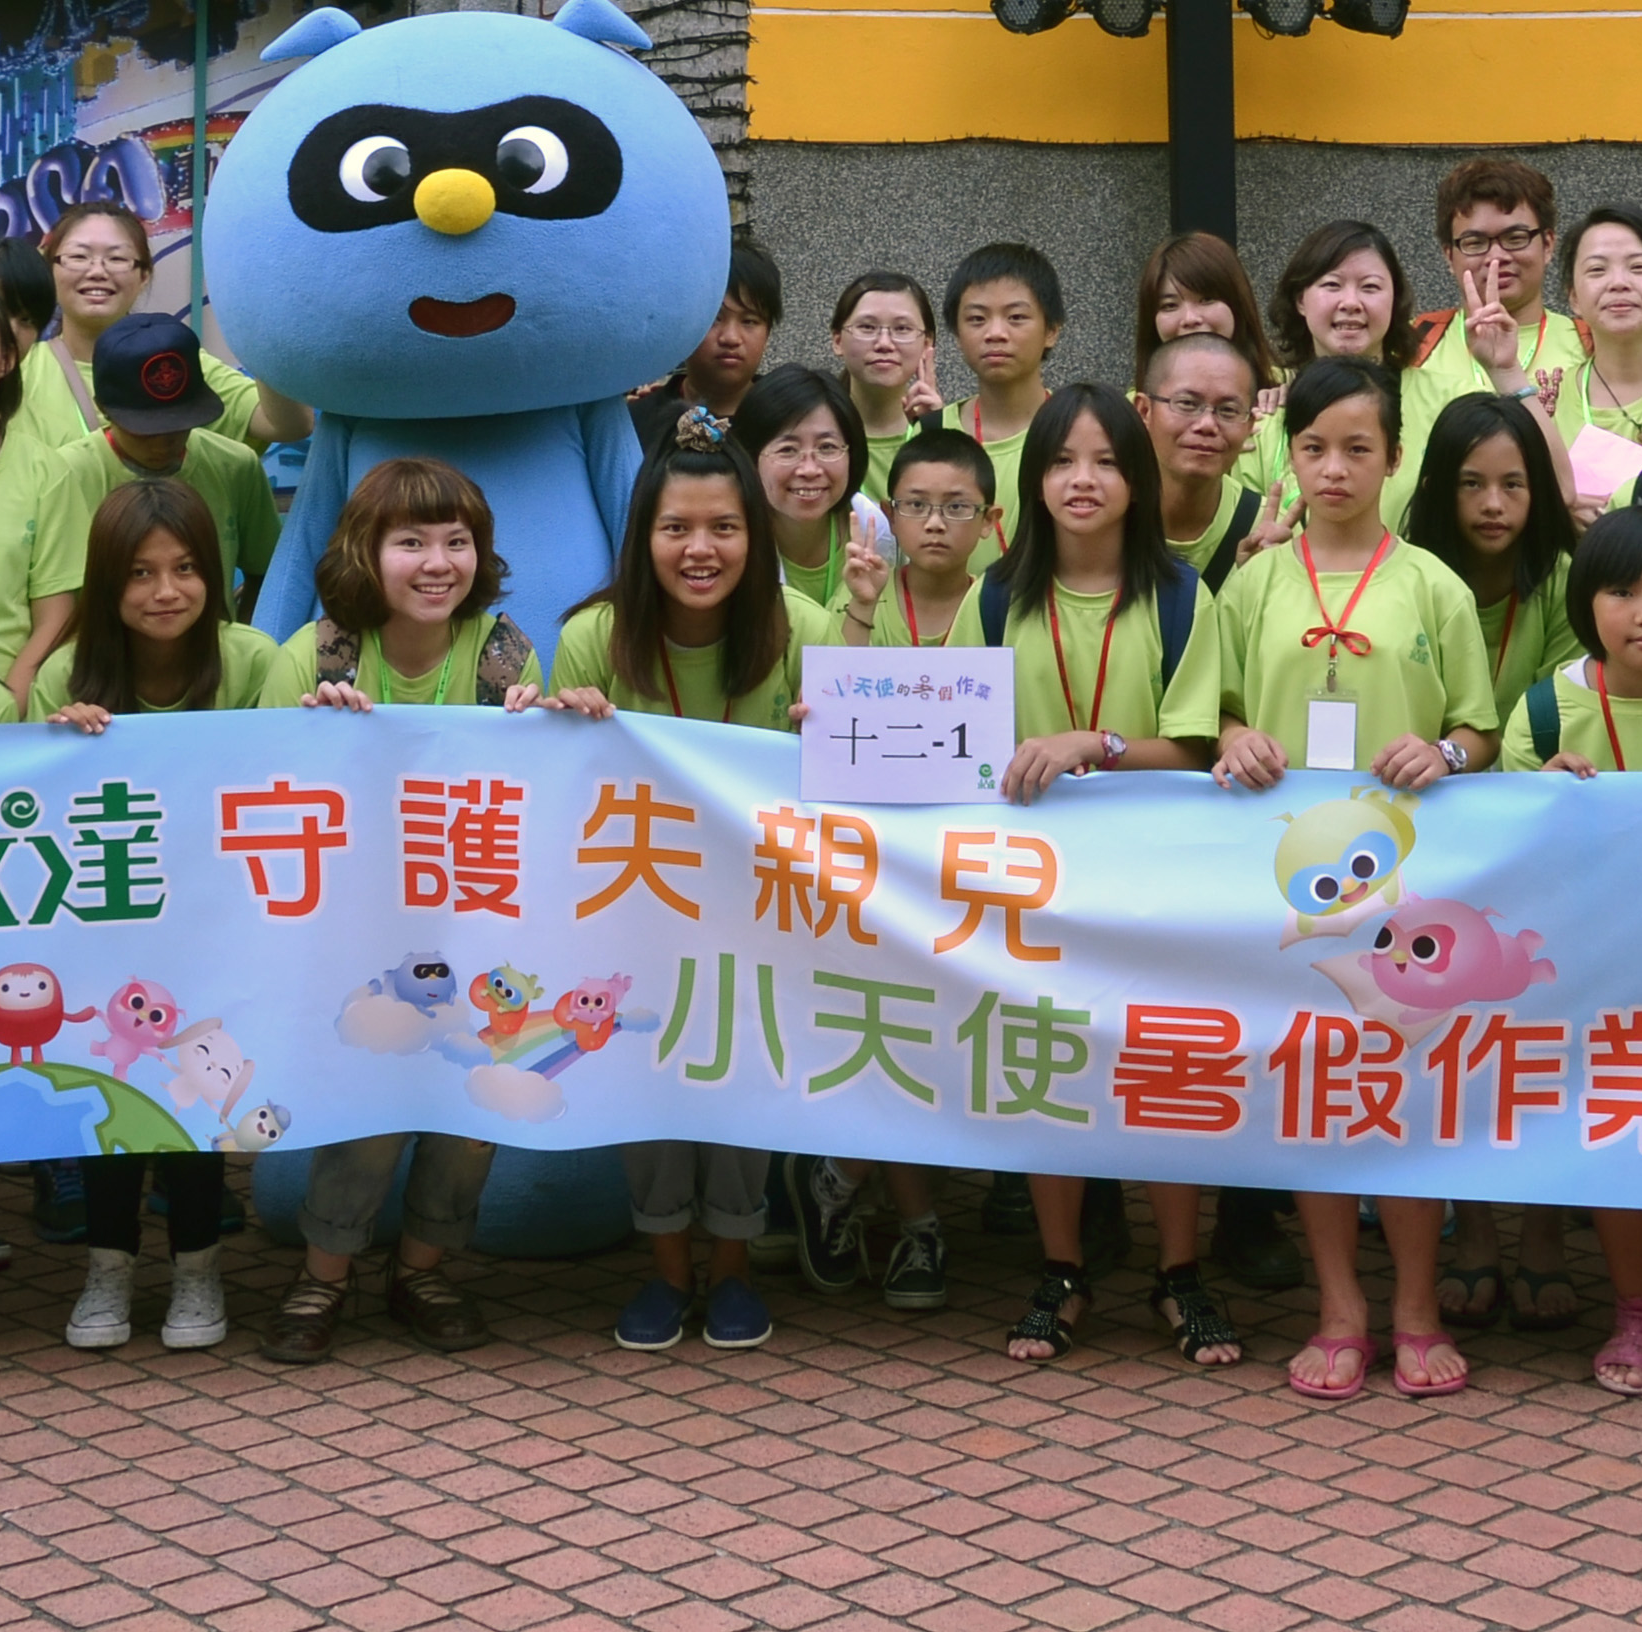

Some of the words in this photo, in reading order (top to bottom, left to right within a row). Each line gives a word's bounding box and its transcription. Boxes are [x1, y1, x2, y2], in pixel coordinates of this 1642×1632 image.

[829, 717, 973, 766] 十二-1
[220, 779, 1063, 963] 守護失親兒
